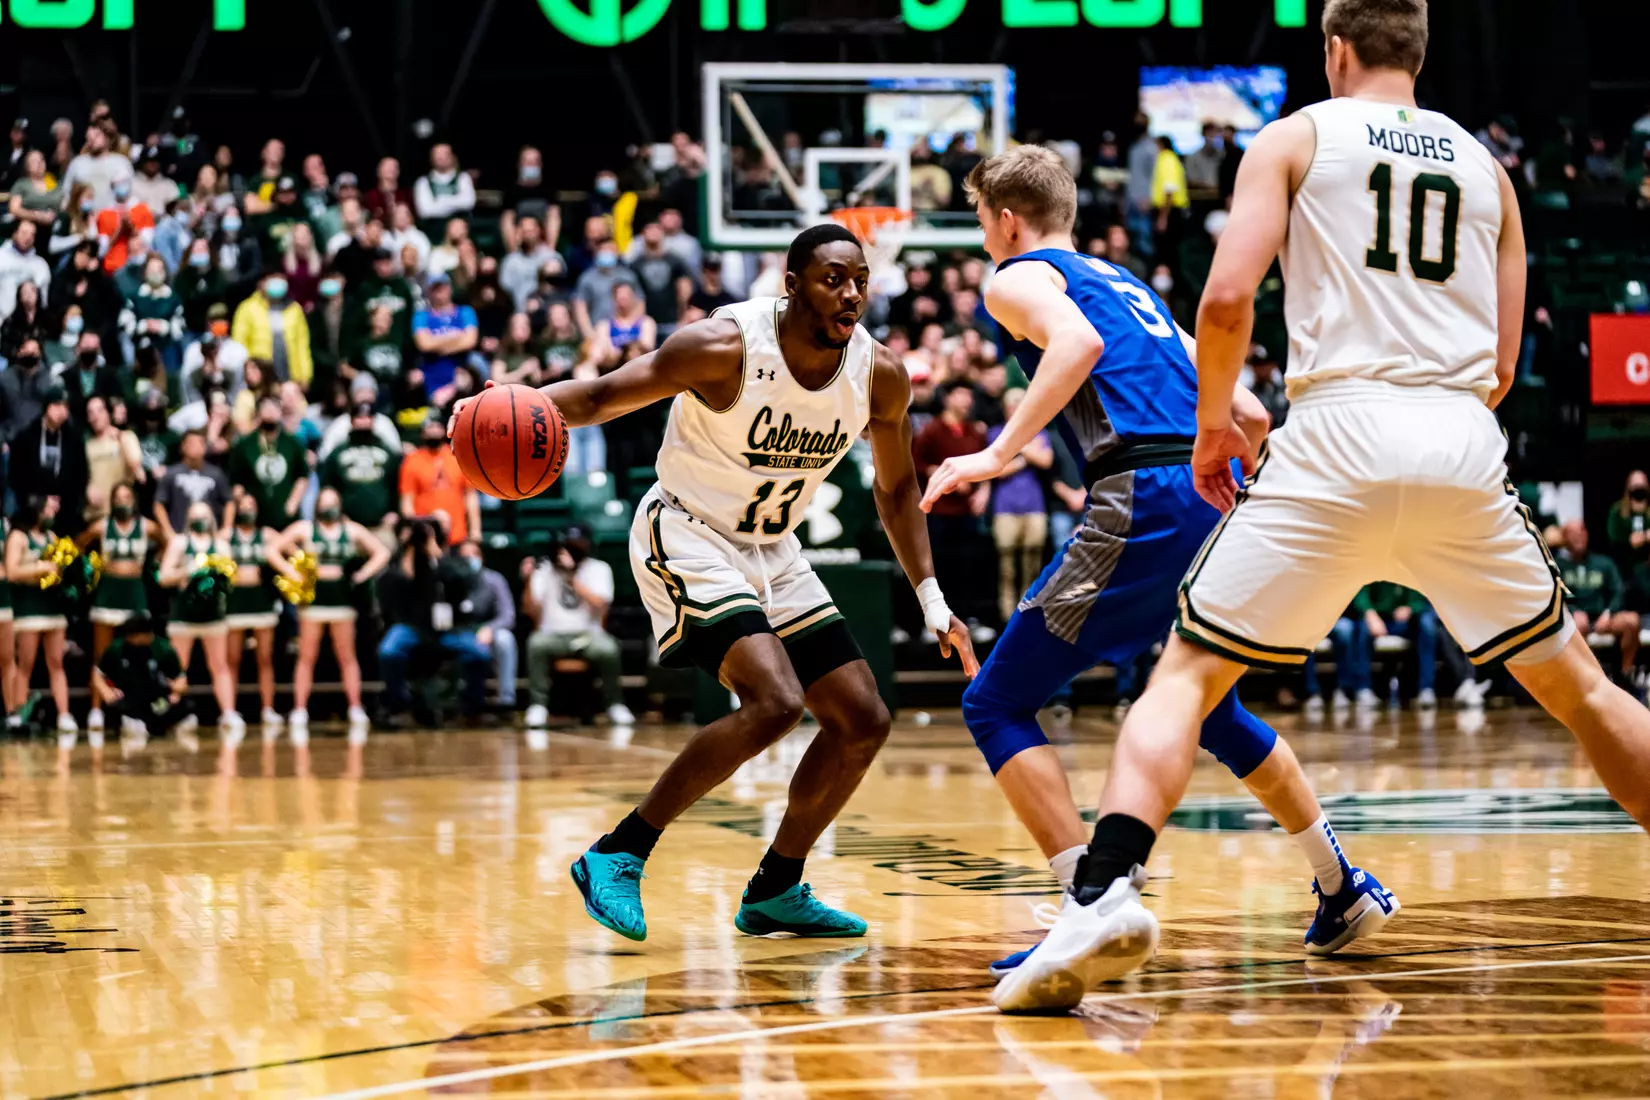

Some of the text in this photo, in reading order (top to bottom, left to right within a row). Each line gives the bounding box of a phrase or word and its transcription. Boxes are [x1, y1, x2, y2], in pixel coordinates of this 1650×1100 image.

[1366, 124, 1455, 162] MOORS
[1365, 162, 1464, 287] 10
[1107, 280, 1174, 338] 3
[529, 404, 548, 460] NCAA
[747, 405, 849, 456] Colorado
[767, 456, 798, 468] STATE
[735, 478, 807, 537] 13
